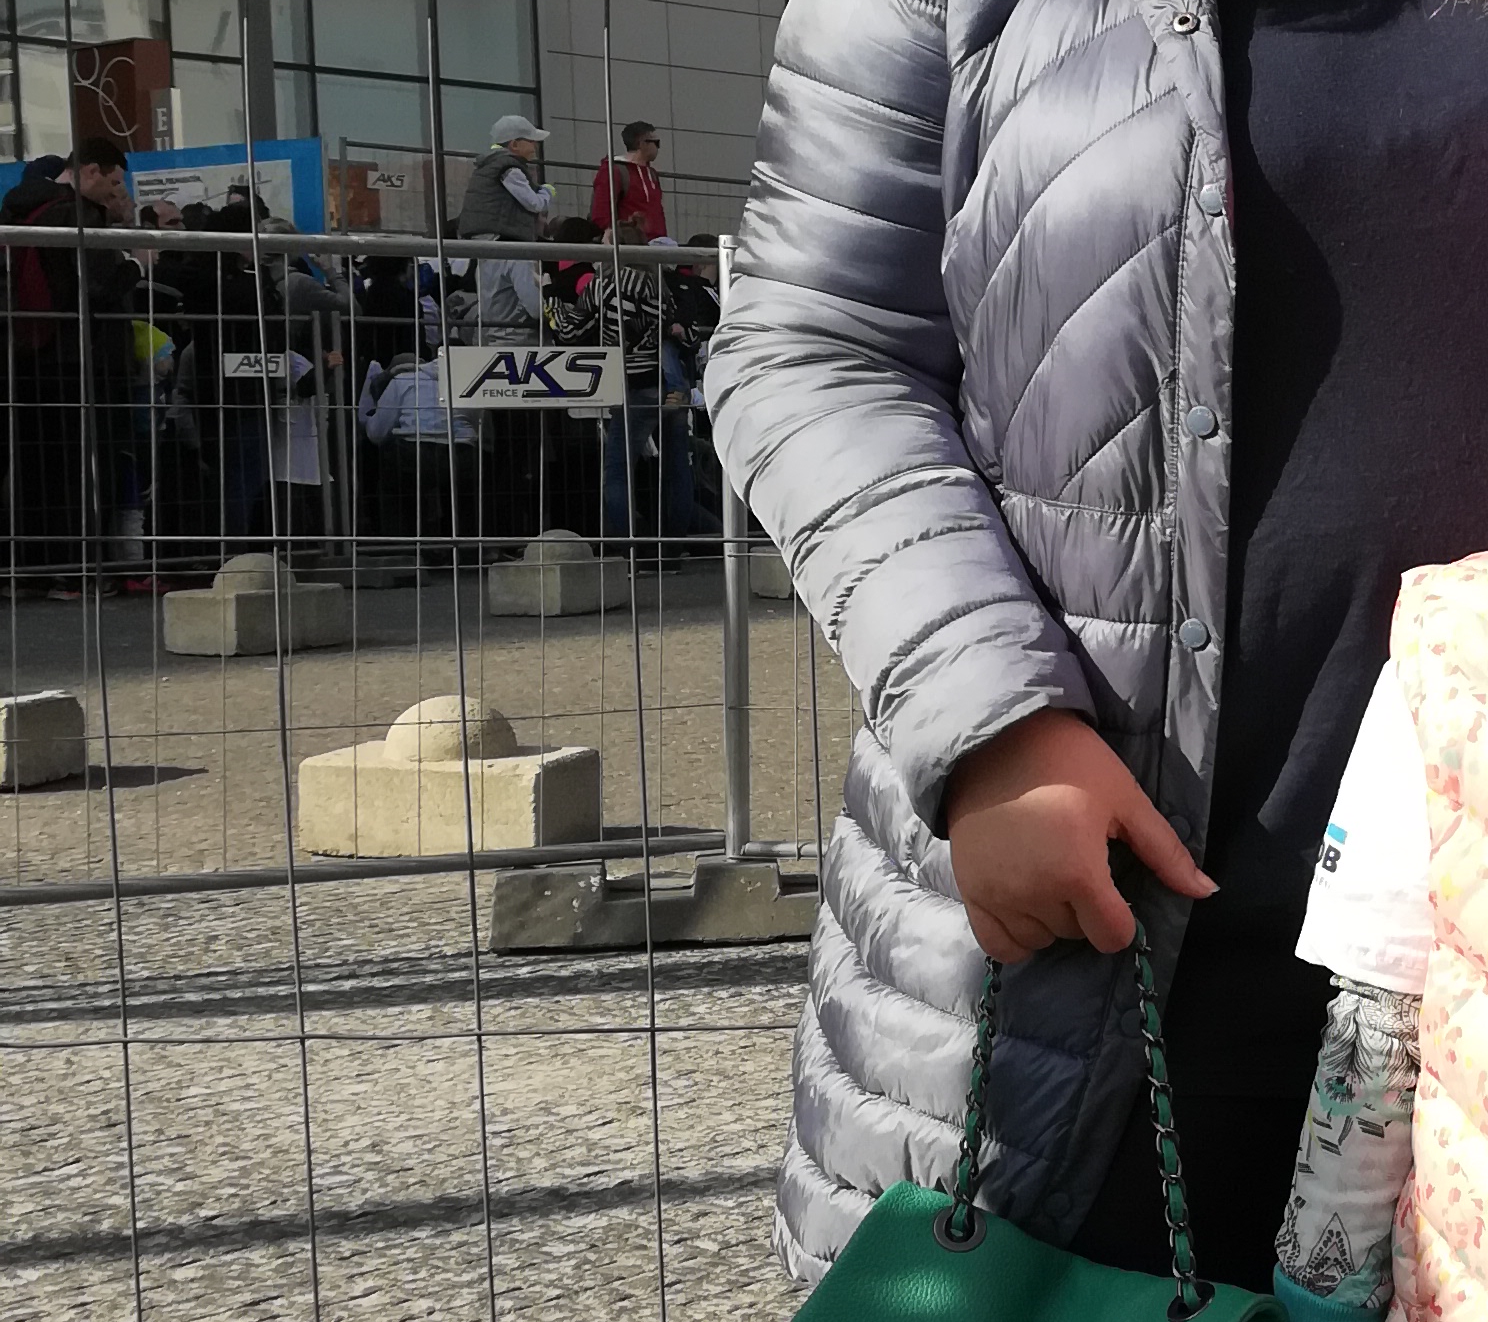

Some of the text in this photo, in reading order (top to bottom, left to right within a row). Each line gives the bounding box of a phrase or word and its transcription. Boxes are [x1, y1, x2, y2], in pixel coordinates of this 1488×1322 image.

[373, 172, 405, 188] AKS
[232, 354, 282, 374] AKS
[459, 350, 608, 399] AKS
[482, 388, 519, 398] FENCE
